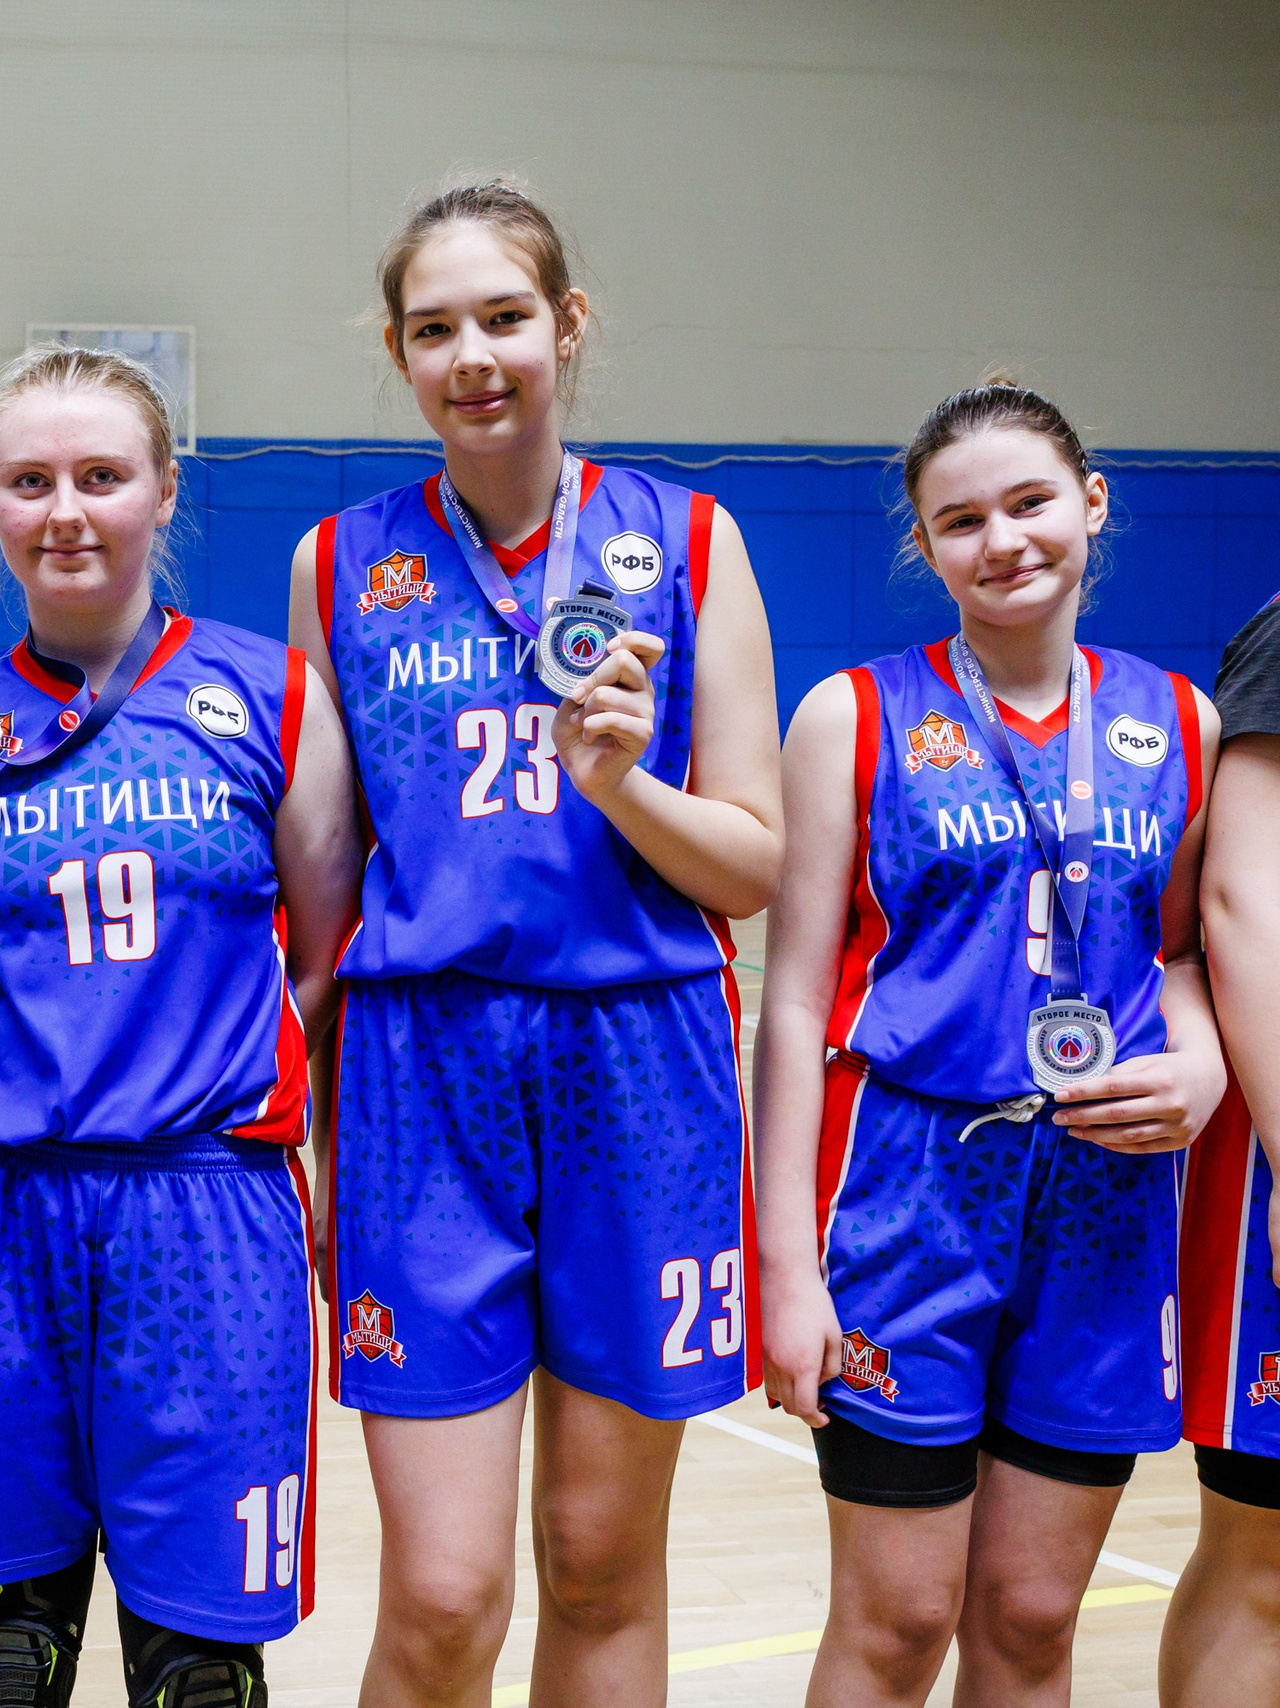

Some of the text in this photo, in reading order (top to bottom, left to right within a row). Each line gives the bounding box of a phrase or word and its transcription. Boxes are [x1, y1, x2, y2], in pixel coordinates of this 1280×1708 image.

[443, 482, 483, 549] МИНИСТЕРСТВО
[554, 496, 568, 539] ОБЛАСТИ
[610, 553, 655, 571] РФБ
[559, 605, 625, 626] ВТОРОЕ МЕСТО
[387, 632, 539, 692] МЫТИ
[964, 657, 997, 723] МИНИСТЕРСТВО
[1072, 681, 1081, 723] ОБЛАСТИ
[455, 703, 560, 819] 23
[1117, 731, 1160, 751] РФБ
[937, 800, 1161, 860] МЫЩИ
[48, 849, 157, 966] 19
[1036, 1011, 1102, 1022] ВТОРОЕ МЕСТО
[659, 1247, 744, 1369] 23
[1160, 1294, 1179, 1402] 9
[234, 1473, 299, 1594] 19
